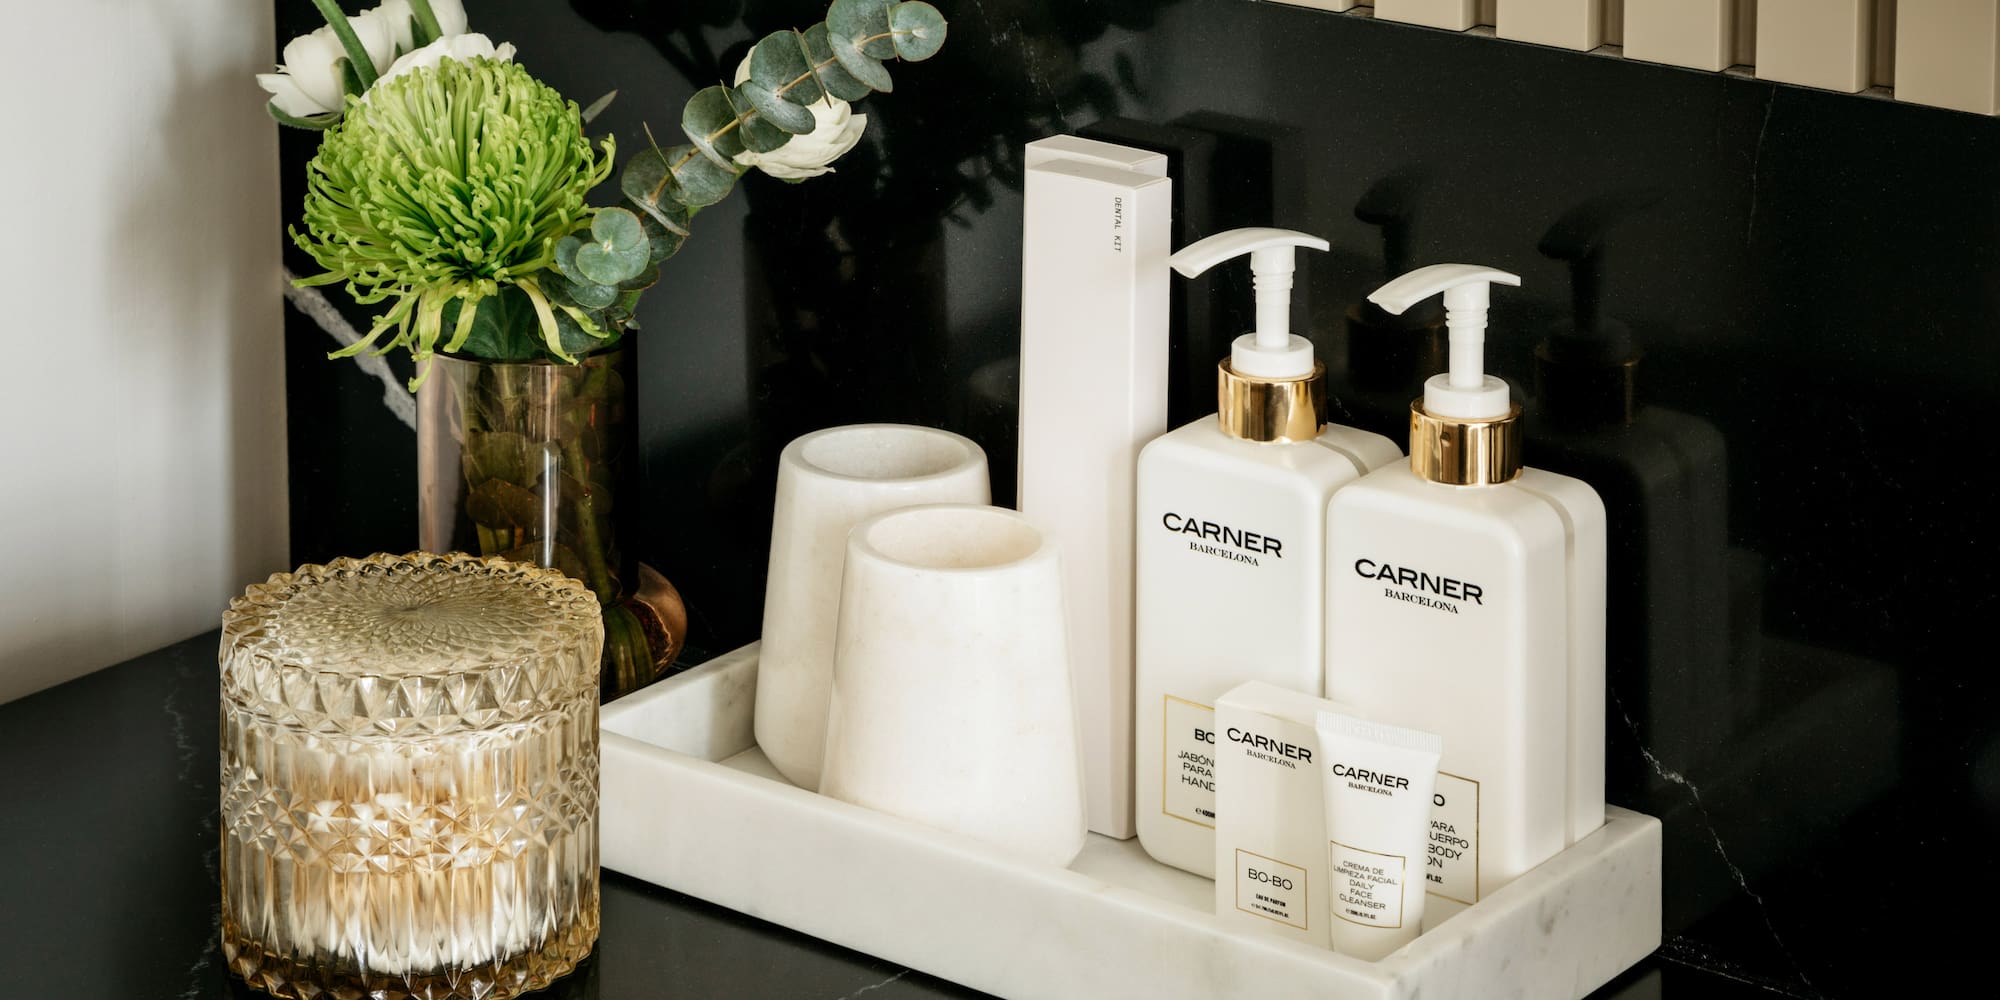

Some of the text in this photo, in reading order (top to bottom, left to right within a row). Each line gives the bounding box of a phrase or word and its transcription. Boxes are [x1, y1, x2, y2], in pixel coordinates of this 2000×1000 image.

[1114, 196, 1122, 229] DENTAL
[1162, 512, 1282, 558] CARNER
[1189, 541, 1259, 566] BARCELONA
[1355, 558, 1483, 605] CARNER
[1384, 588, 1459, 614] BARCELONA
[1227, 728, 1312, 764] CARNER
[1178, 750, 1215, 768] JABÓN
[1246, 749, 1296, 769] BARCELONA
[1183, 762, 1213, 778] PARA
[1333, 764, 1409, 790] CARNER
[1348, 782, 1393, 797] BARCELONA
[1431, 820, 1456, 834] ARA
[1343, 860, 1384, 876] CREMA DE
[1248, 868, 1293, 890] BO-BO
[1350, 879, 1374, 890] DAILY
[1367, 875, 1398, 885] FACIAL
[1339, 893, 1386, 910] CLEANSER
[1350, 888, 1373, 899] FACE
